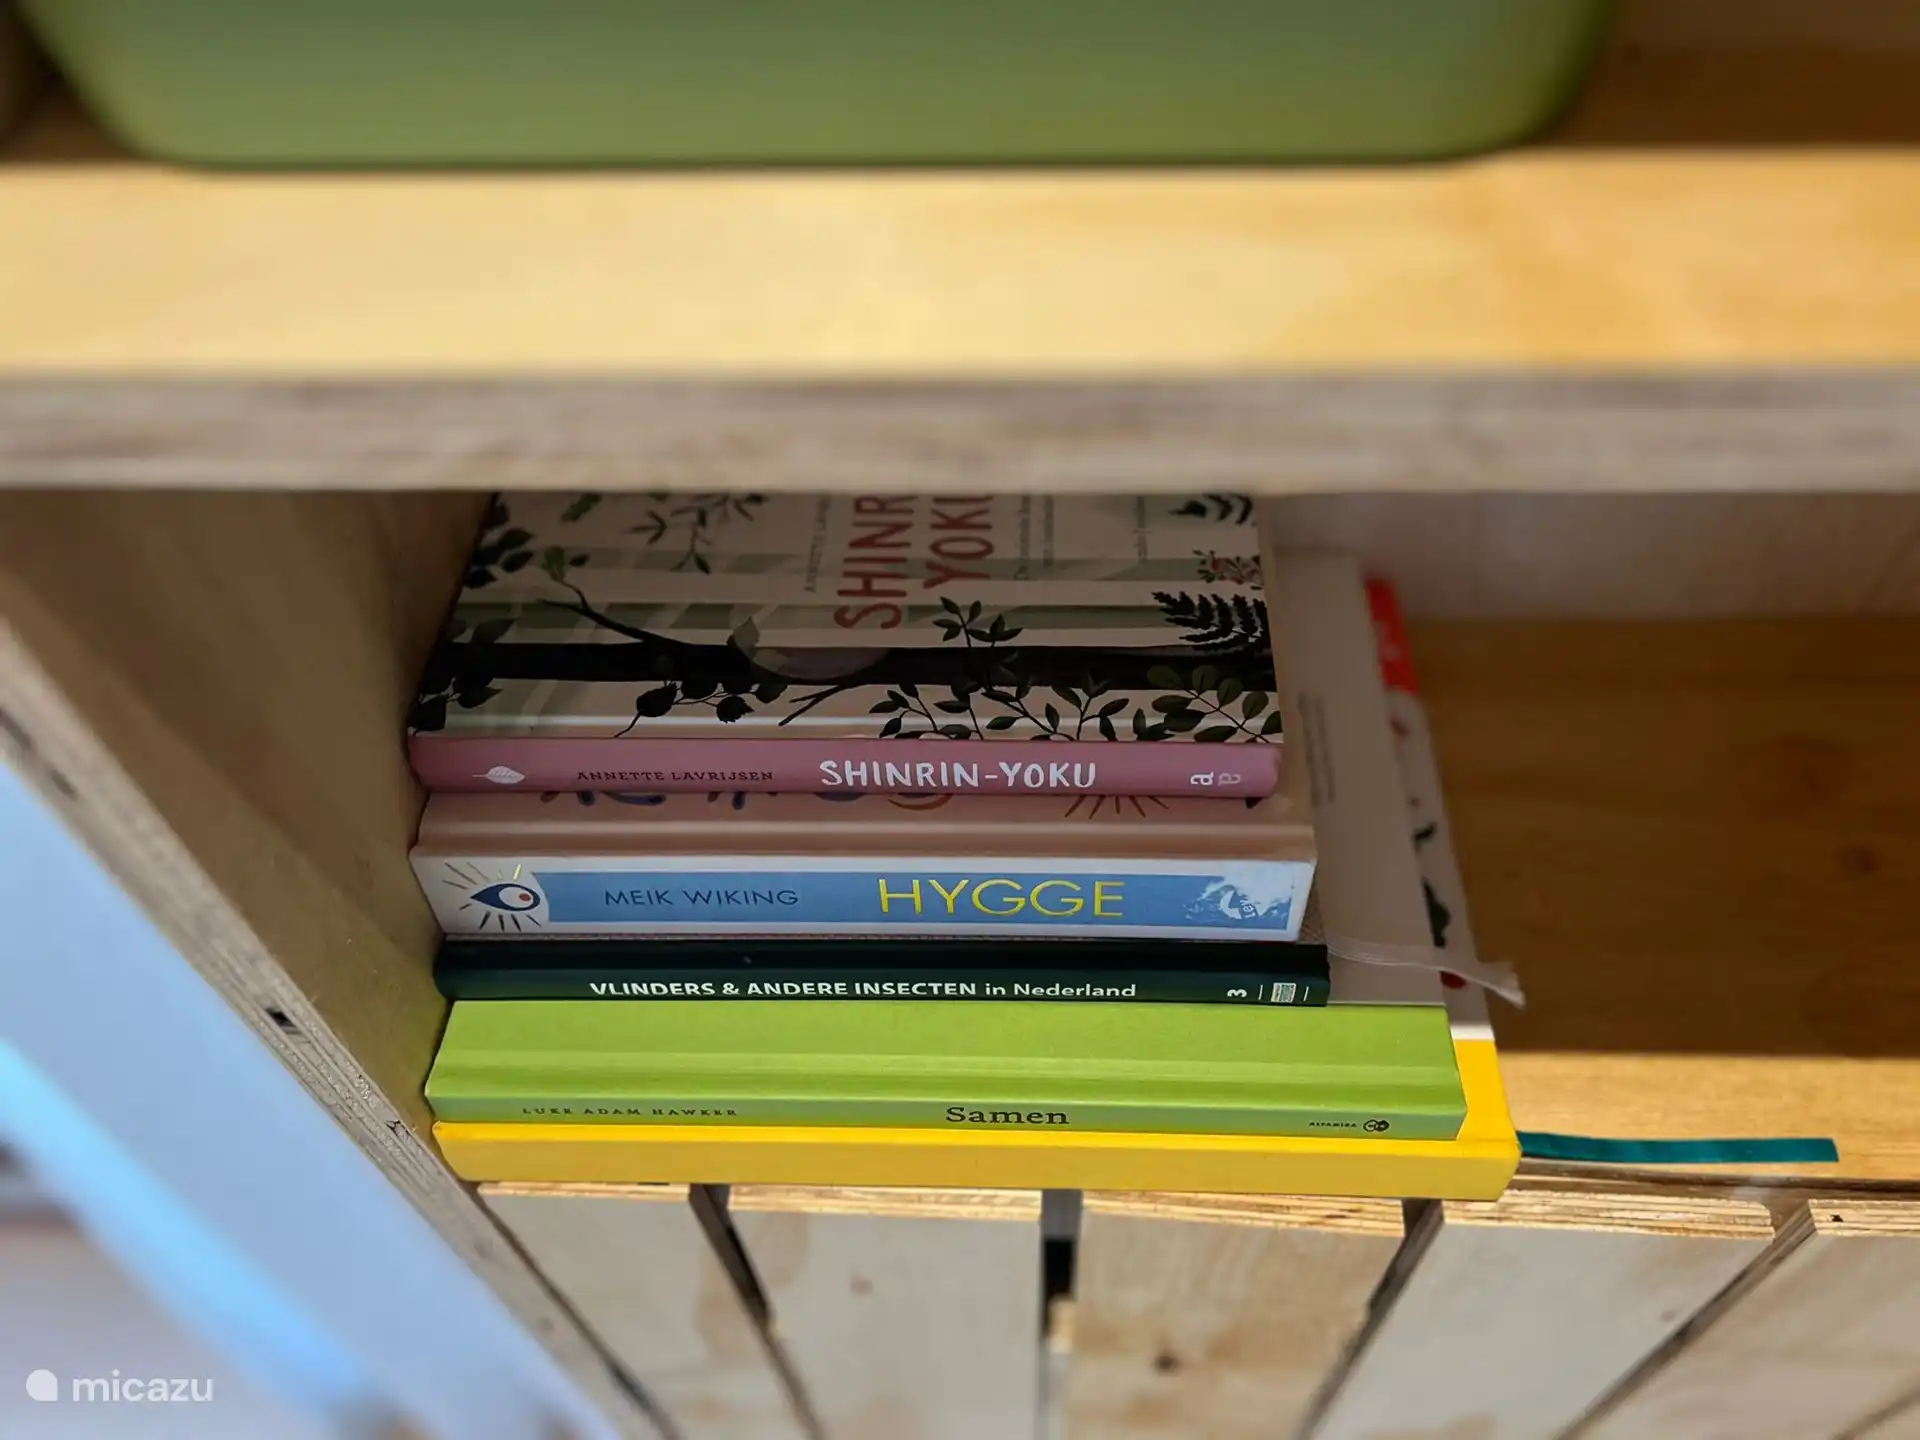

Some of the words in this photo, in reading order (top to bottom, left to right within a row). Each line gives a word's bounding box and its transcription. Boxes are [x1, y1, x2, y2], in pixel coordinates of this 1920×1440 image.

[577, 771, 665, 780] ANNETTE
[672, 771, 774, 780] LAVRIJSEN
[819, 760, 1097, 788] SHINRIN-YOKU
[605, 889, 673, 906] MEIK
[682, 889, 799, 906] WIKING
[878, 878, 1125, 916] HYGGE
[590, 982, 716, 996] VLINDERS
[722, 982, 739, 995] &
[747, 982, 848, 996] ANDERE
[855, 982, 976, 996] INSECTEN
[985, 983, 1006, 996] in
[1013, 983, 1136, 997] Nederland
[583, 1108, 641, 1116] ADAM
[652, 1108, 738, 1116] HAWKER
[946, 1106, 1069, 1124] Samen
